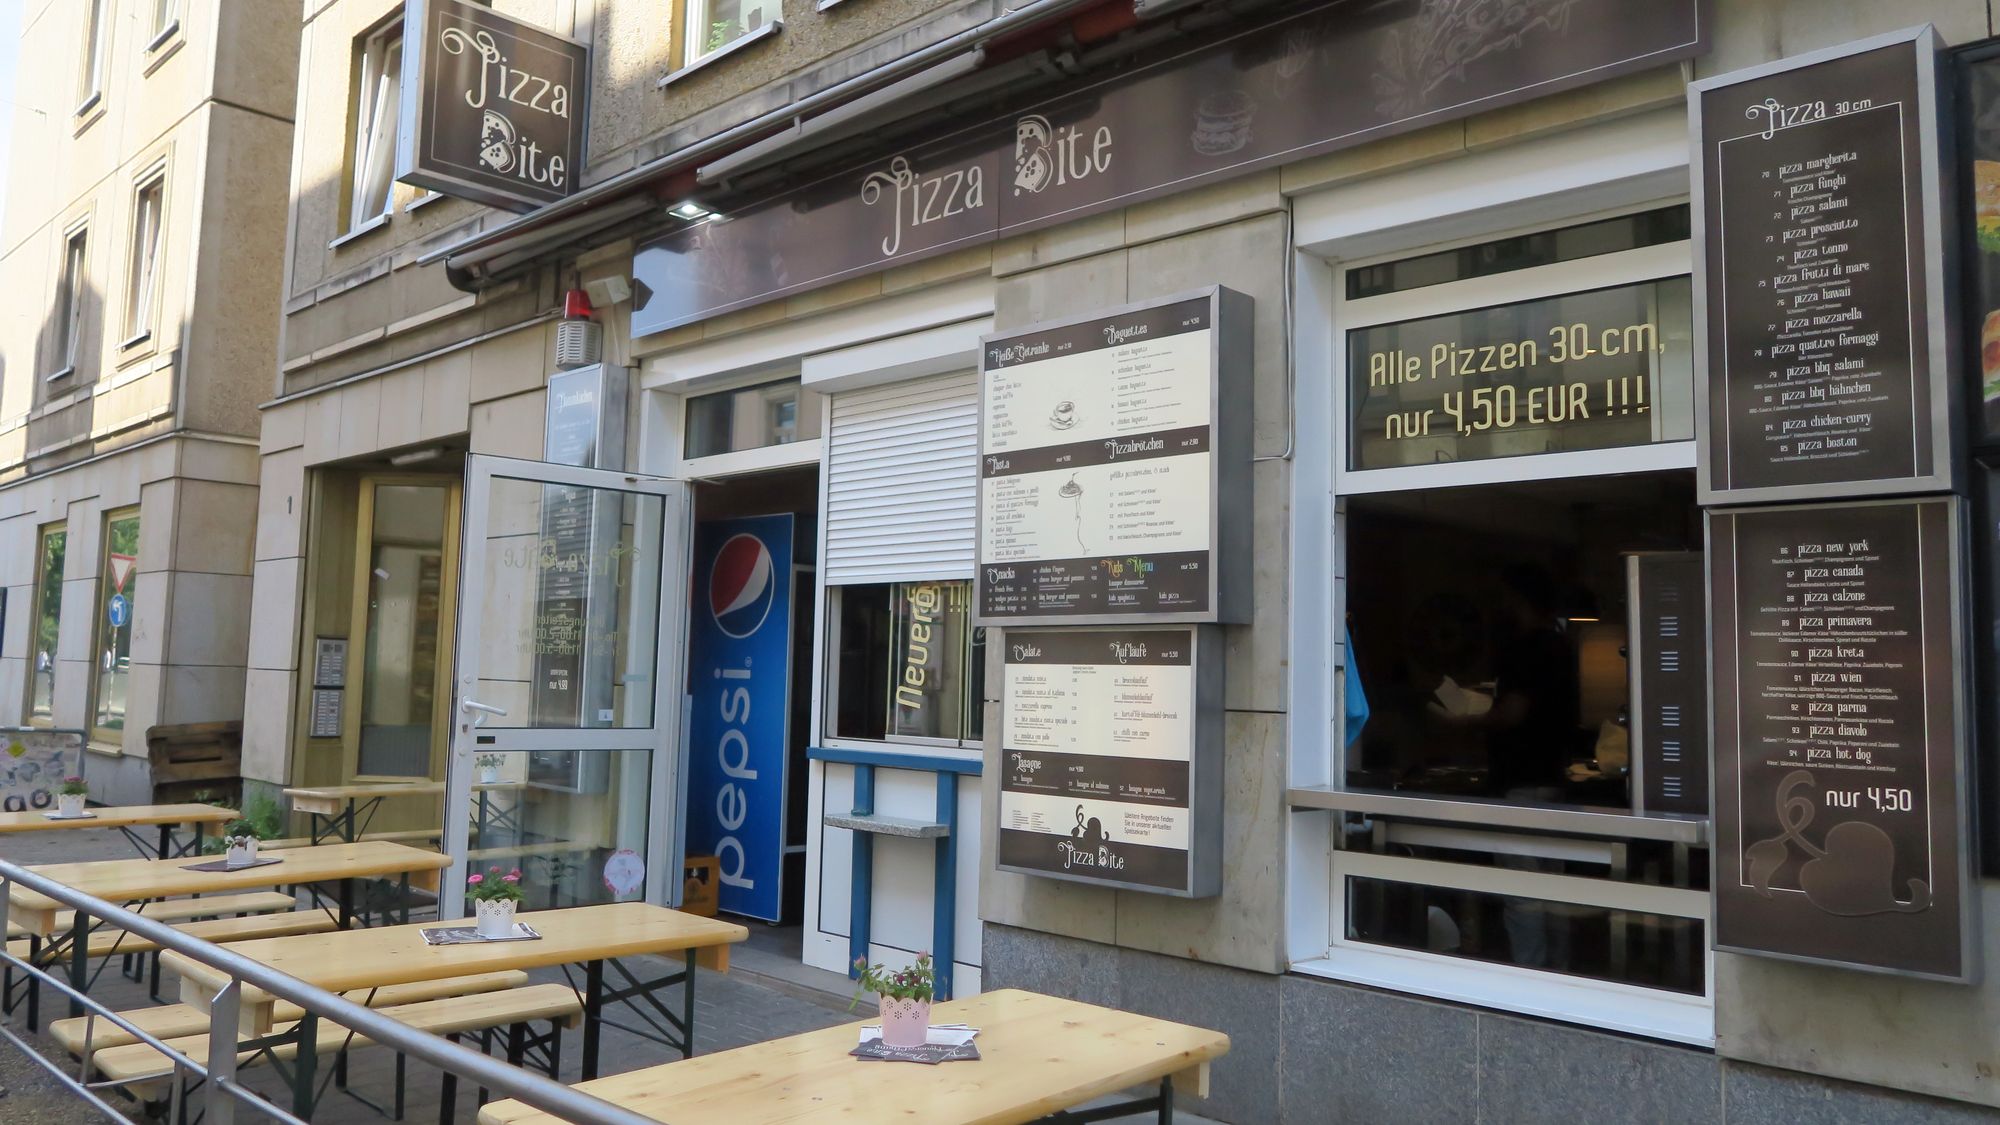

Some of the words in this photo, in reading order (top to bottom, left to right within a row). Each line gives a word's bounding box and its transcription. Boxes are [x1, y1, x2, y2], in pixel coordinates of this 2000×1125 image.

[441, 27, 568, 118] Pizza
[1746, 98, 1825, 139] Pizza
[1835, 102, 1849, 114] 30
[1853, 100, 1871, 111] cm
[480, 109, 564, 187] Bite
[1779, 161, 1802, 178] pizza
[1807, 152, 1856, 169] margherita
[861, 156, 983, 256] Pizza
[1014, 115, 1112, 197] Bite
[1791, 182, 1814, 198] pizza
[1818, 174, 1846, 189] funghi
[1791, 204, 1814, 220] pizza
[1819, 197, 1847, 211] salami
[1783, 227, 1806, 243] pizza
[1811, 219, 1858, 238] prosciutto
[1794, 247, 1817, 263] pizza
[1822, 243, 1848, 254] tonno
[1774, 272, 1797, 288] pizza
[1801, 267, 1829, 281] frutti
[1833, 264, 1841, 276] di
[1846, 262, 1869, 274] mare
[1795, 291, 1818, 307] pizza
[1823, 287, 1851, 300] hawaii
[1786, 317, 1809, 332] pizza
[1813, 308, 1861, 325] mozzarella
[1103, 325, 1147, 345] Baguettes
[1772, 342, 1794, 358] pizza
[1799, 338, 1835, 355] quattro
[1839, 331, 1879, 347] formaggi
[1370, 350, 1421, 387] Alle
[1431, 339, 1536, 379] Pizzen
[1549, 323, 1588, 363] 30
[1602, 323, 1665, 356] cm,
[1787, 364, 1810, 380] pizza
[1815, 361, 1830, 376] bbq
[1835, 358, 1864, 370] salami
[1782, 388, 1805, 404] pizza
[1810, 385, 1825, 400] bbq
[1829, 382, 1870, 396] hähnchen
[1386, 410, 1433, 439] nur
[1443, 385, 1515, 437] 4,50
[1528, 383, 1590, 424] EUR
[1783, 417, 1806, 433] pizza
[1811, 413, 1871, 427] chicken-curry
[1104, 437, 1164, 459] Pizzabrötchen
[1798, 437, 1822, 454] pizza
[1827, 437, 1856, 448] boston
[987, 455, 1010, 474] Pasta
[1798, 542, 1821, 557] pizza
[1826, 544, 1843, 552] new
[1849, 539, 1869, 555] york
[987, 568, 1015, 584] Snacks
[1100, 559, 1123, 577] Kids
[1127, 556, 1153, 578] Menu
[1805, 566, 1828, 581] pizza
[1833, 564, 1863, 576] canada
[1805, 590, 1828, 605] pizza
[1833, 589, 1865, 602] calzone
[1800, 615, 1823, 630] pizza
[1828, 616, 1872, 630] primavera
[1013, 644, 1041, 661] Salate
[1109, 641, 1147, 664] Aufläufe
[1809, 646, 1832, 661] pizza
[1837, 646, 1864, 657] kreta
[1811, 671, 1835, 686] pizza
[1840, 672, 1861, 683] wien
[1809, 701, 1832, 716] pizza
[1838, 704, 1866, 716] parma
[1810, 724, 1833, 738] pizza
[1838, 724, 1867, 737] diavolo
[1011, 752, 1042, 773] Lasagne
[1807, 747, 1831, 761] pizza
[1836, 747, 1851, 759] hot
[1856, 750, 1871, 764] dog
[713, 667, 757, 890] pepsi
[1826, 790, 1860, 808] nur
[1867, 788, 1912, 813] 4,50
[1057, 840, 1094, 869] Pizza
[1098, 844, 1124, 870] Bite
